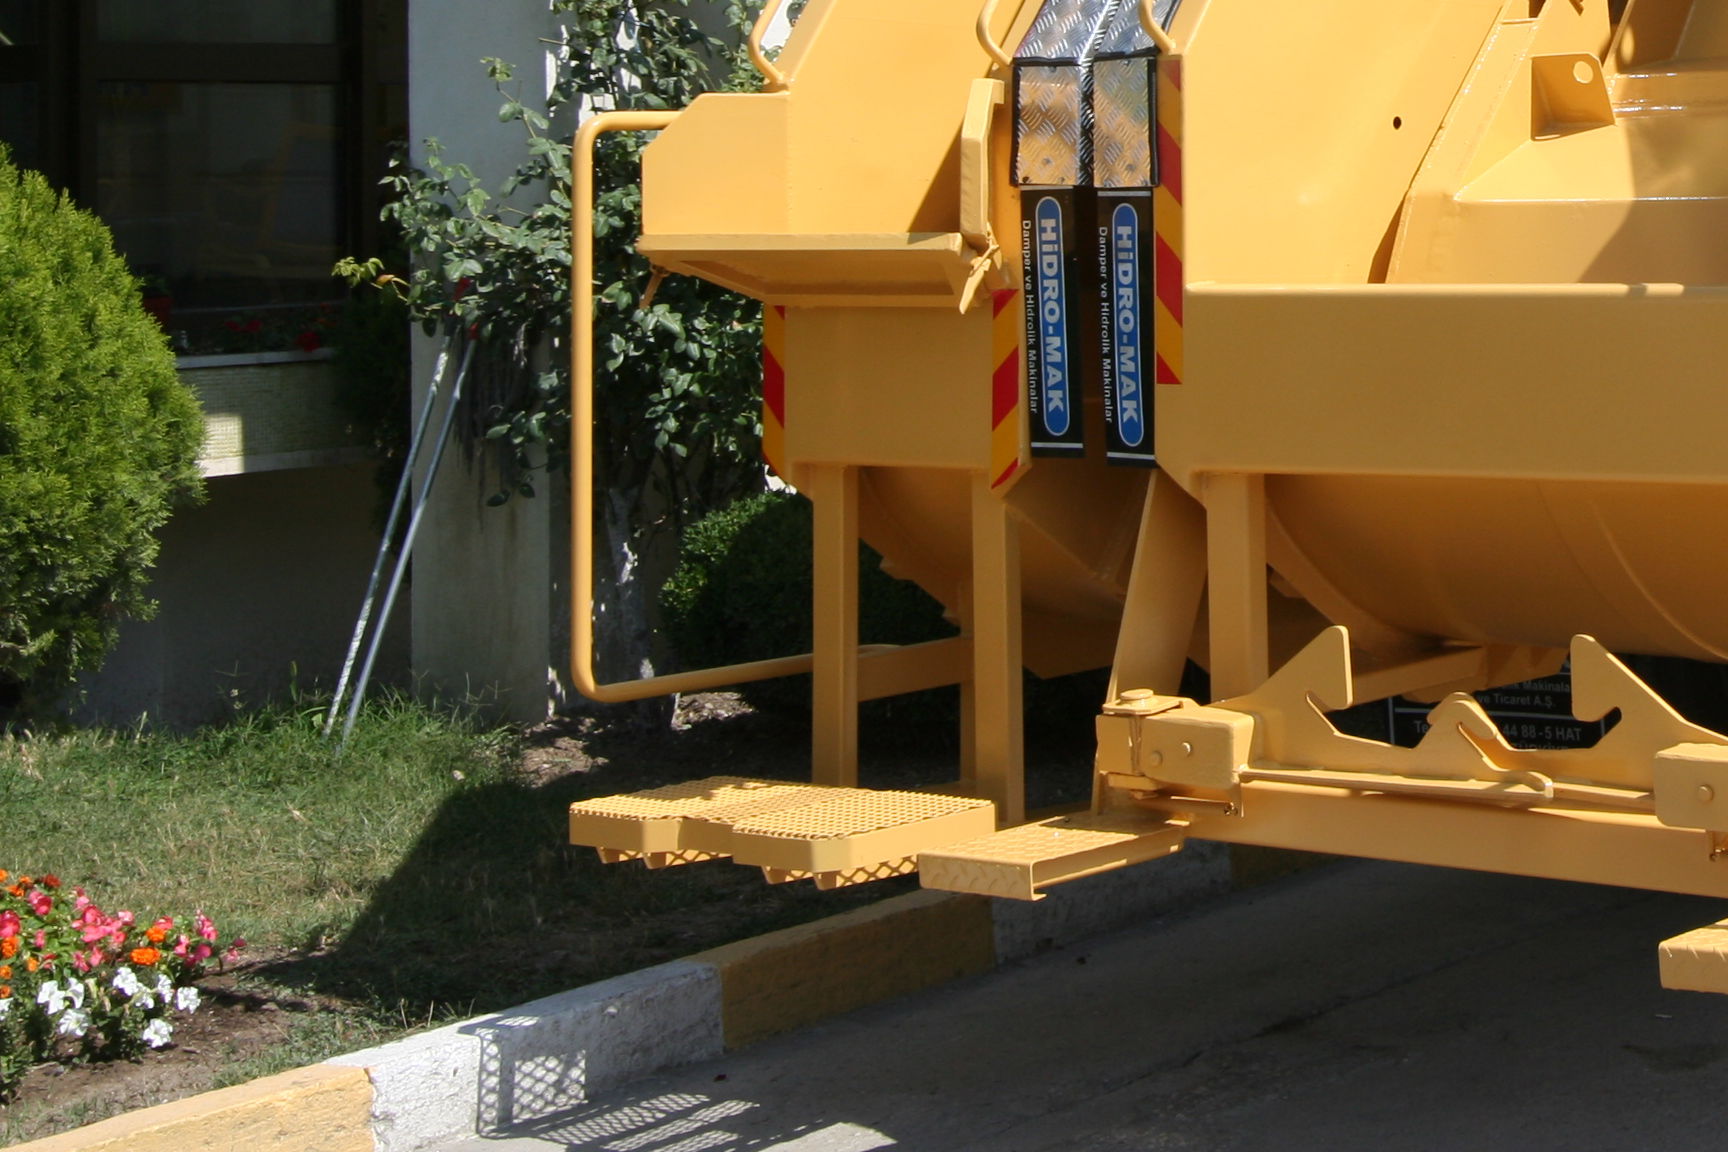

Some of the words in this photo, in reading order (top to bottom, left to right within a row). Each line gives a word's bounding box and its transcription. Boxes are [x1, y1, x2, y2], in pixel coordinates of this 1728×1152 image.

[1022, 220, 1032, 272] Damper
[1098, 227, 1108, 278] Damper
[1025, 275, 1032, 290] ve
[1100, 283, 1108, 298] ve
[1026, 294, 1036, 345] Hidrolik
[1101, 302, 1111, 354] Hidrolik
[1028, 350, 1038, 414] Makinalar
[1102, 358, 1114, 424] Makinalar
[1522, 679, 1570, 693] Makinala
[1556, 726, 1582, 741] HAT
